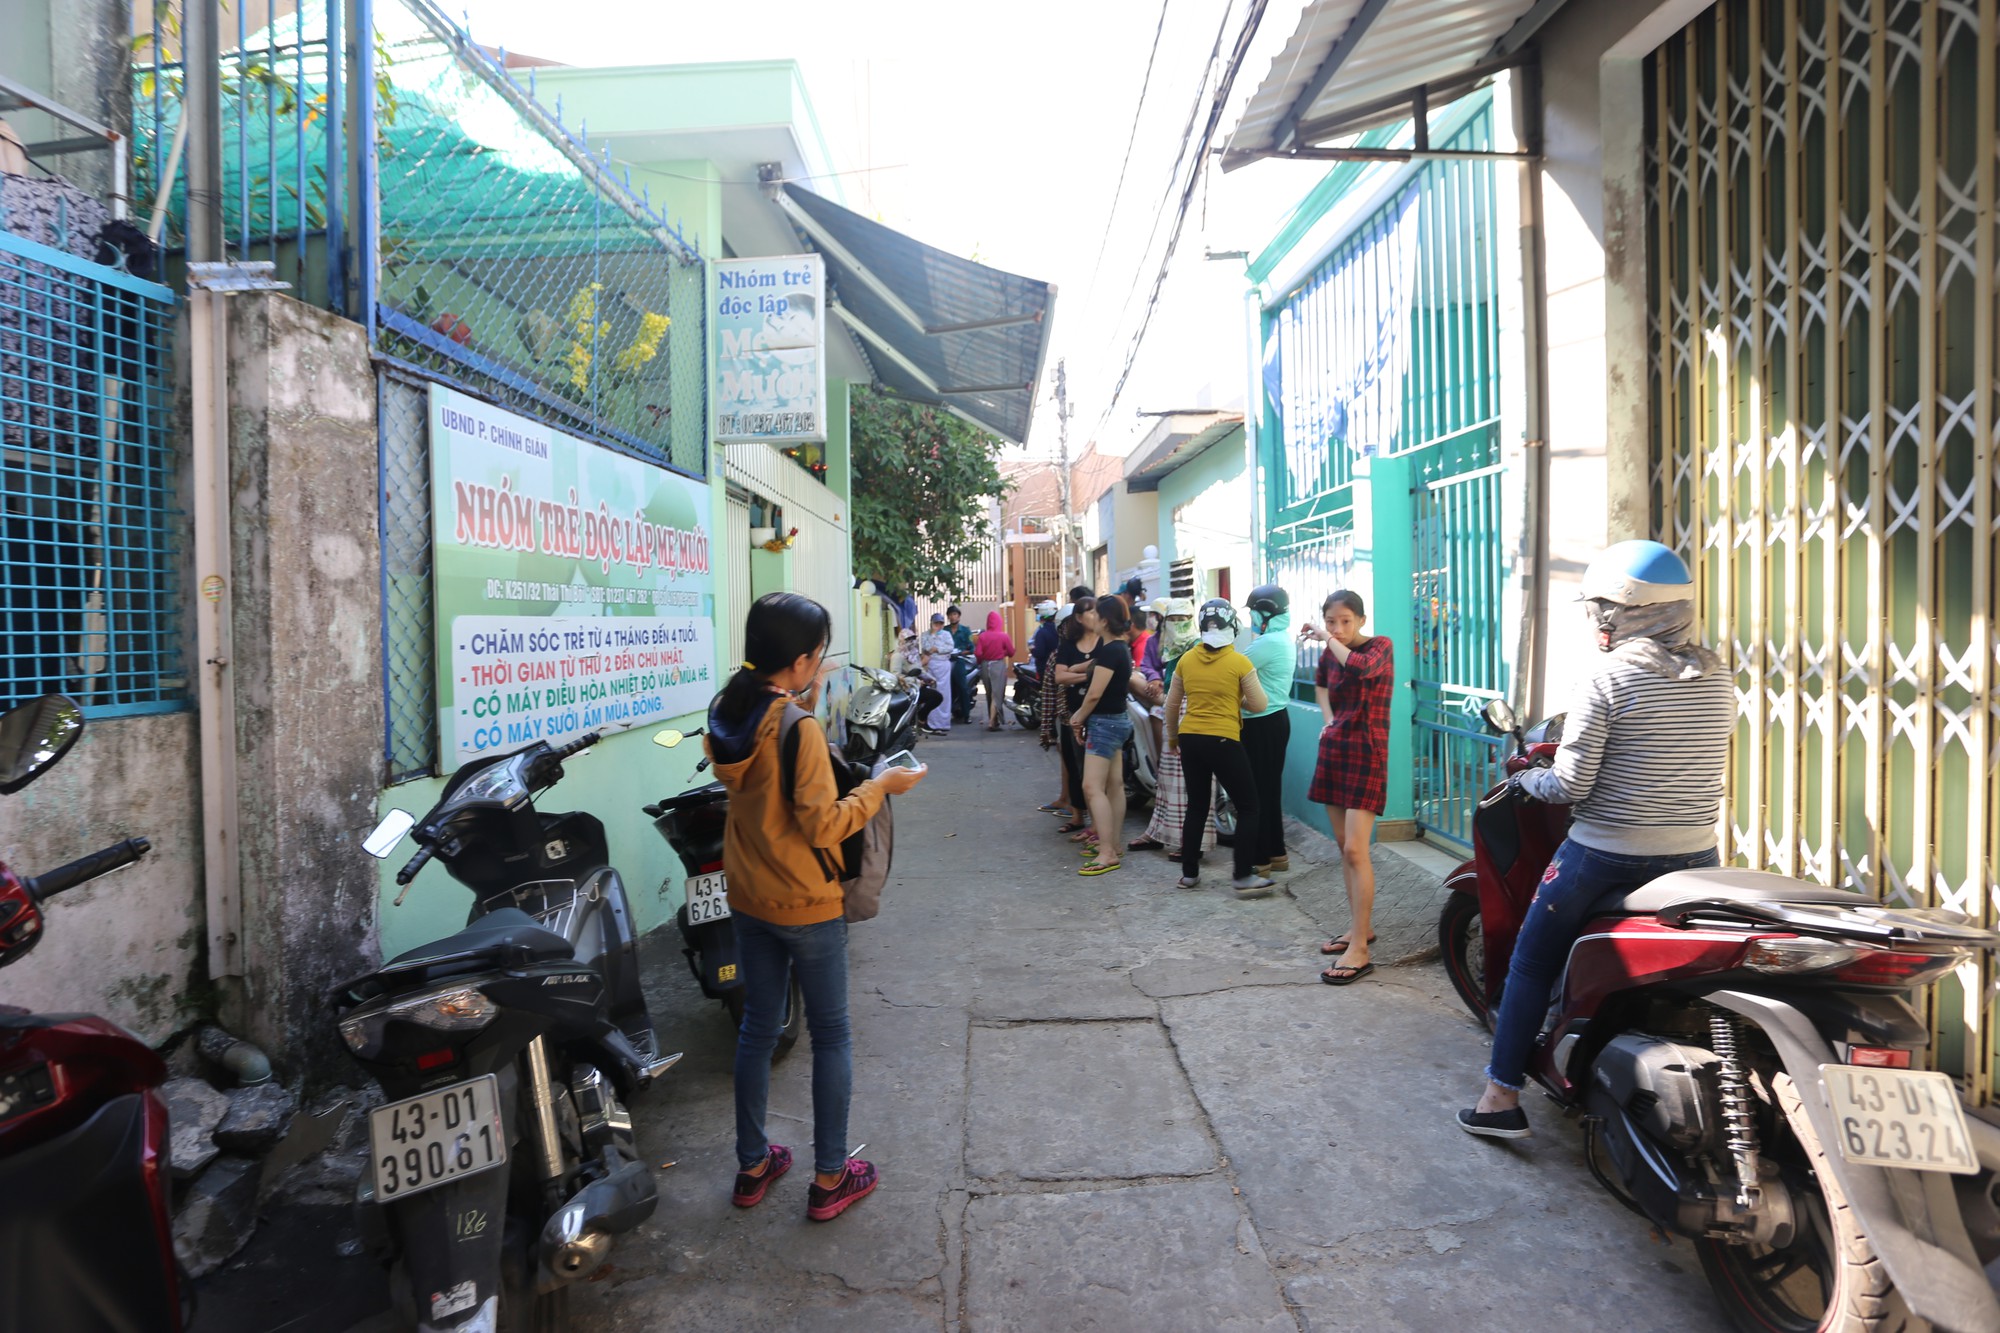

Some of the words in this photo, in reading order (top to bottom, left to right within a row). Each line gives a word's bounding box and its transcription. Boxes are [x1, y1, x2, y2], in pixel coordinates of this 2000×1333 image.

[718, 269, 776, 289] Nhóm
[782, 264, 811, 286] trẻ
[718, 295, 752, 320] độc
[758, 293, 789, 318] lập
[441, 407, 475, 436] UBND
[478, 420, 488, 441] P.
[490, 426, 523, 452] CHÍNH
[775, 412, 794, 432] 467
[453, 474, 536, 551] NHÓM
[538, 486, 582, 556] TRẺ
[584, 499, 622, 574] ĐỘC
[623, 509, 655, 576] LẬP
[655, 525, 677, 579] MẸ
[471, 628, 524, 655] CHĂM
[529, 627, 560, 653] SÓC
[563, 625, 584, 651] TRẺ
[588, 626, 602, 648] TỪ
[605, 631, 612, 648] 4
[614, 625, 649, 646] THÁNG
[652, 623, 669, 645] ĐẾN
[671, 629, 677, 644] 4
[471, 658, 512, 687] THỜI
[517, 661, 556, 682] GIAN
[560, 654, 576, 678] TỪ
[578, 651, 603, 677] THỨ
[605, 656, 611, 673] 2
[614, 647, 635, 671] ĐẾN
[637, 646, 658, 669] CHỦ
[473, 689, 502, 718] CÓ
[507, 686, 541, 714] MÁY
[546, 678, 576, 708] ĐIỀU
[580, 679, 607, 702] HÒA
[610, 672, 639, 698] NHIỆT
[641, 670, 656, 695] ĐỘ
[679, 665, 697, 685] MÙA
[473, 720, 503, 750] CÓ
[507, 715, 542, 744] MÁY
[547, 707, 579, 736] SƯỞI
[582, 702, 602, 729] ẤM
[605, 699, 630, 723] MÙA
[695, 873, 728, 898] 43-D
[691, 897, 728, 922] 626.
[391, 1086, 477, 1145] 43-D1
[1846, 1072, 1939, 1118] 43-D1
[381, 1124, 493, 1195] 390.61
[1843, 1115, 1968, 1168] 623.24
